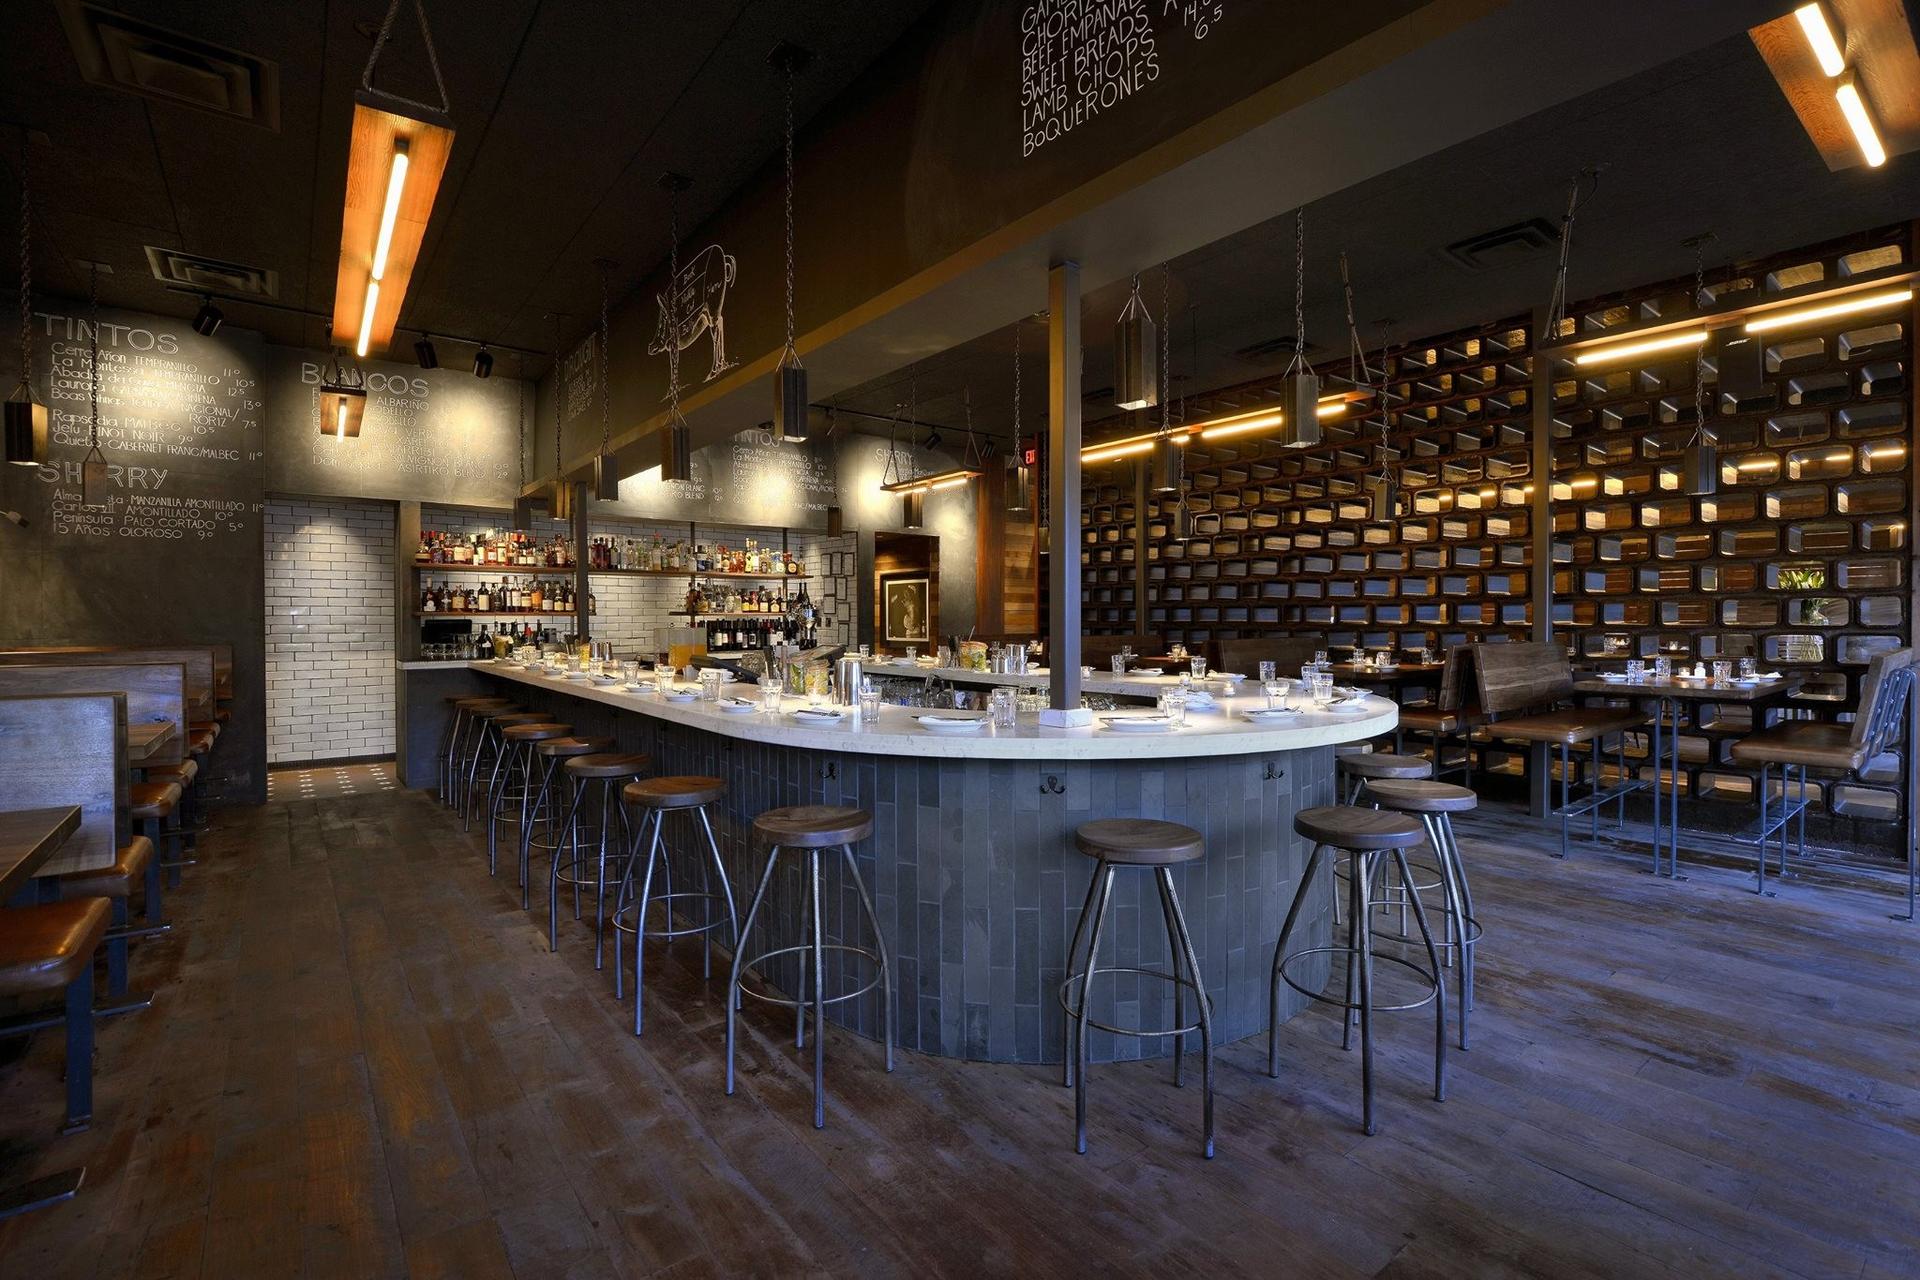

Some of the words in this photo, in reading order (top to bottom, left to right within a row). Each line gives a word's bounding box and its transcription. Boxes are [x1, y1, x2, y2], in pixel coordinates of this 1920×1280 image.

[1022, 0, 1105, 56] CHORIZ
[1020, 55, 1068, 107] SWEET
[1074, 4, 1149, 76] BREADS
[1022, 39, 1054, 83] BEEF
[1023, 84, 1068, 132] LAMB
[1077, 28, 1155, 95] CHOPS
[34, 312, 179, 355] TINTOS
[52, 354, 73, 366] La
[135, 355, 198, 373] TEMPRANILLO
[301, 362, 430, 398] BLANCOS
[51, 388, 85, 400] Boas
[376, 396, 430, 412] ALBARIÑO
[189, 413, 227, 427] RORIZ
[133, 430, 167, 443] NOIR
[107, 439, 162, 454] CABERNET
[38, 460, 168, 489] SHRRY
[51, 500, 97, 513] Carlos
[126, 505, 201, 519] AMONTILLADO
[131, 495, 182, 508] MANZANILLA
[185, 499, 245, 512] AMONTILLADO
[74, 523, 110, 536] Años
[119, 526, 183, 539] OLOROSO
[124, 515, 155, 527] PALO
[158, 517, 216, 530] CORTADO
